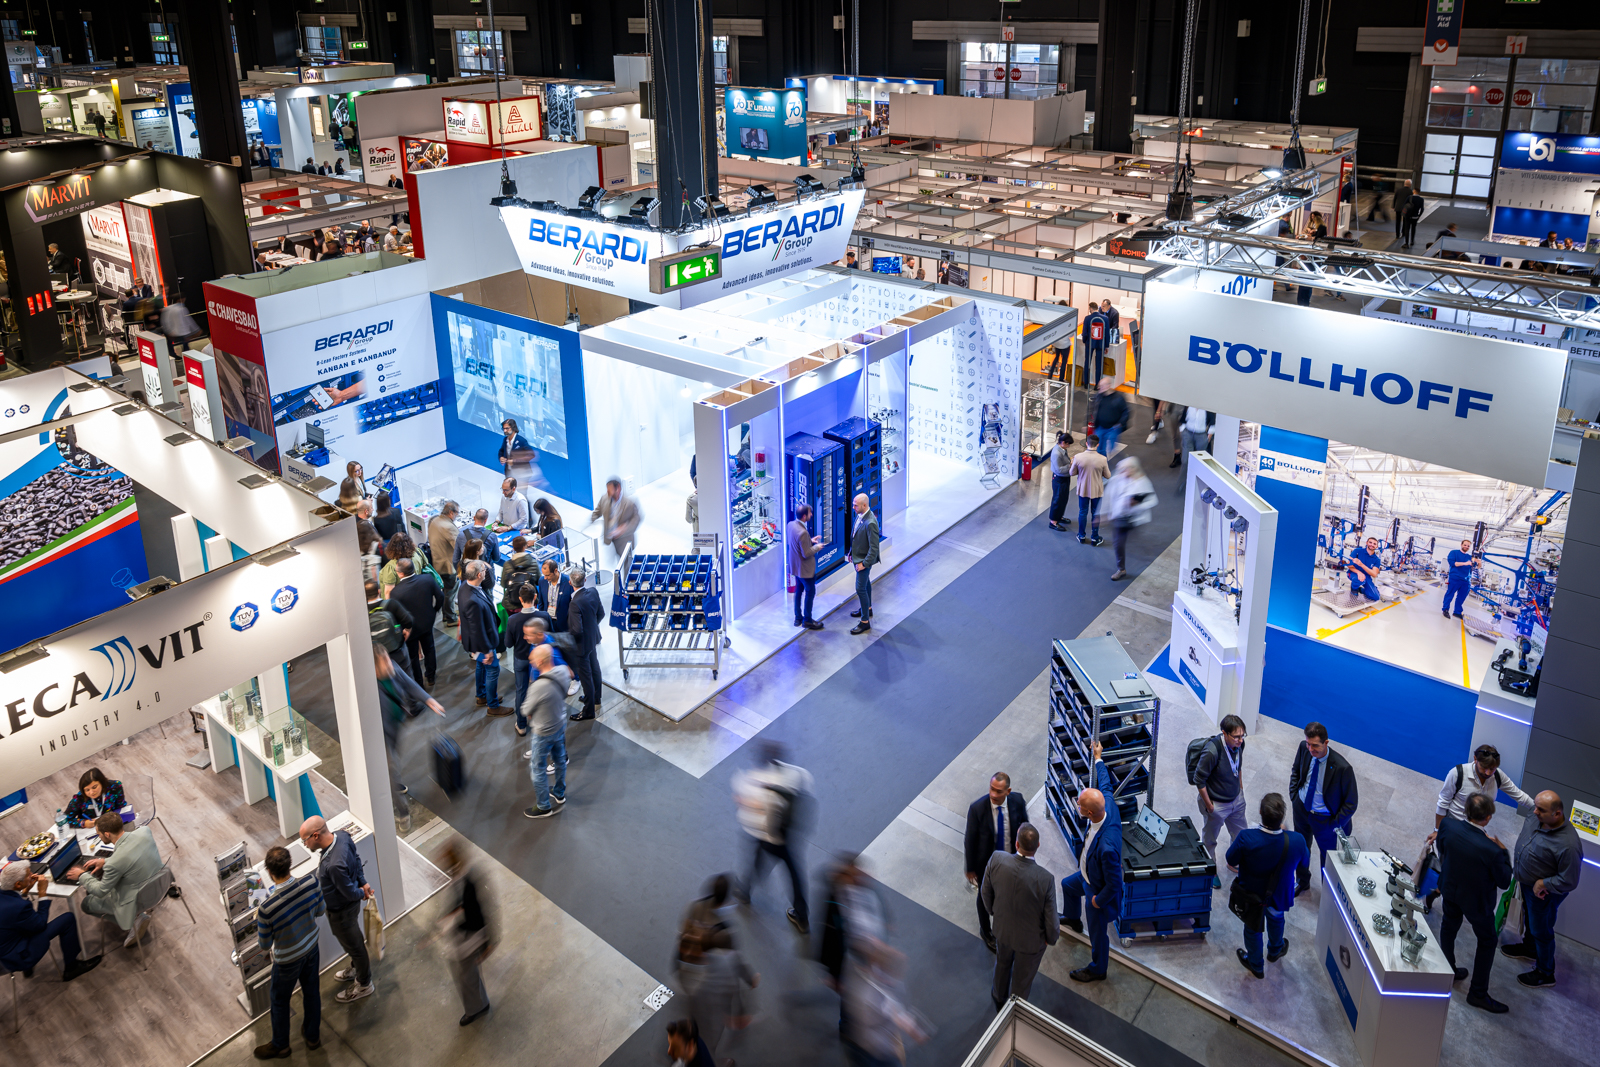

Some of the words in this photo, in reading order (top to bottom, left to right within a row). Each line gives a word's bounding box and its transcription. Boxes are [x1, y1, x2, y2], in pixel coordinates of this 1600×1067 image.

[1004, 32, 1014, 41] 10
[1510, 42, 1523, 53] 11
[1010, 70, 1022, 78] STOP
[135, 109, 167, 119] BRALO
[747, 100, 776, 113] FUSANI
[448, 117, 466, 127] Rapid
[370, 153, 396, 165] Rapid
[31, 175, 92, 211] MARVIT
[90, 214, 120, 238] MARVIT
[722, 203, 845, 259] BERARDI
[529, 218, 648, 264] BERARDI
[784, 236, 813, 251] Group
[585, 252, 614, 269] Group
[530, 261, 552, 273] Advanced
[567, 269, 591, 282] innovative
[592, 276, 616, 287] solutions.
[722, 276, 748, 290] Advanced
[748, 271, 764, 282] ideas,
[765, 262, 790, 276] innovative
[791, 256, 813, 269] solutions.
[216, 303, 258, 330] CHAVESBAO
[314, 319, 394, 352] BERARDI
[354, 336, 374, 345] Group
[317, 361, 349, 375] KANBAN
[358, 347, 397, 364] KANBANUP
[332, 353, 348, 361] Factory
[349, 348, 367, 357] Systems
[465, 358, 547, 398] BERARDI
[1188, 334, 1493, 419] BÖLLHOFF
[1261, 457, 1273, 466] 40
[278, 593, 292, 604] TÜV
[237, 610, 252, 621] TÜV
[0, 671, 102, 739] ECA
[40, 710, 119, 756] INDUSTRY
[136, 691, 161, 711] 4.0
